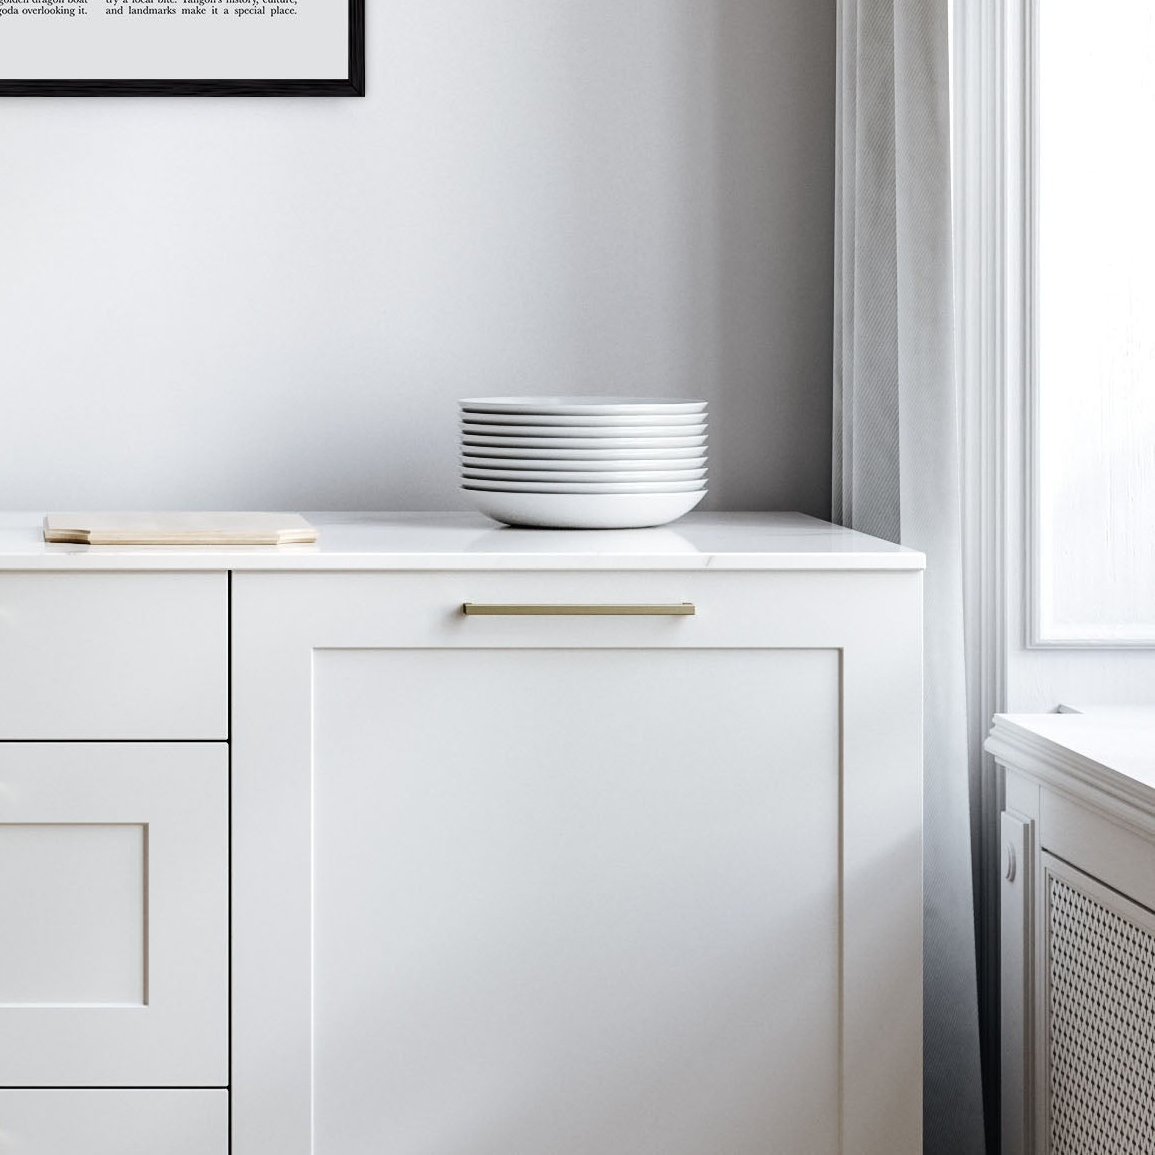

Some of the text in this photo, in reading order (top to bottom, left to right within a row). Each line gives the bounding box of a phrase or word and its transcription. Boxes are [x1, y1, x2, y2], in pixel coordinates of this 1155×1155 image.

[22, 6, 75, 17] overlooking
[79, 6, 87, 14] it.
[106, 6, 123, 14] and
[129, 6, 176, 14] landmarks
[182, 6, 206, 14] make
[212, 6, 218, 14] it
[235, 6, 265, 17] special
[271, 6, 297, 17] place.
